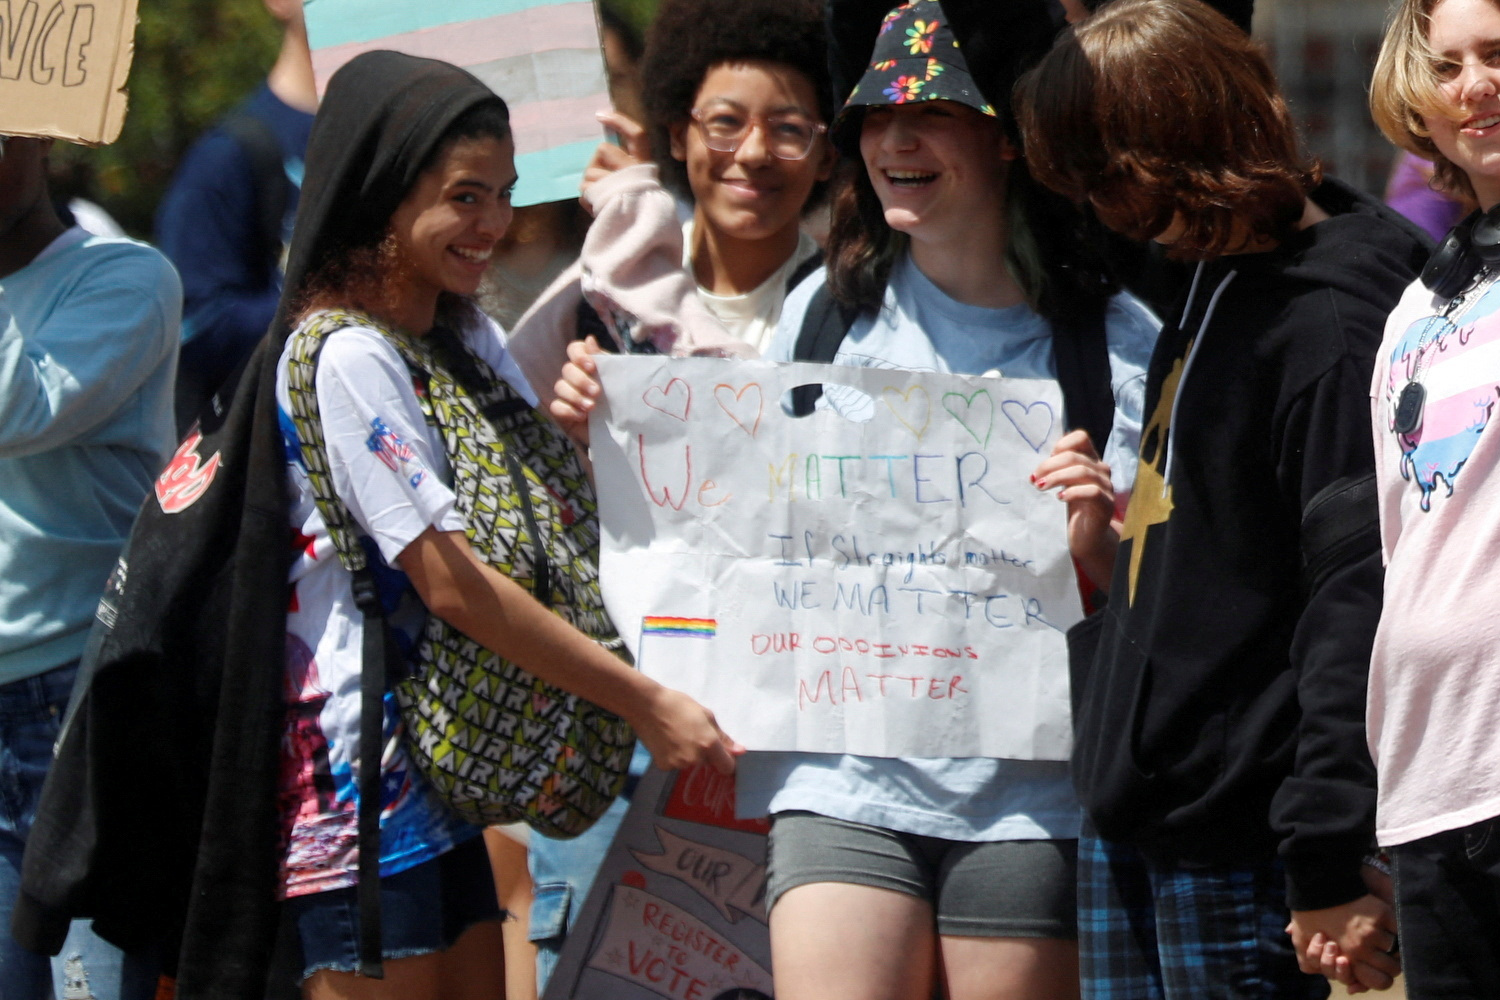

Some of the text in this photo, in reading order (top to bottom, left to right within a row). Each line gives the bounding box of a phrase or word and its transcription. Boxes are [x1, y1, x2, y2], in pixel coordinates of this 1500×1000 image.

[0, 0, 95, 88] NCE
[639, 433, 732, 511] We
[769, 451, 1011, 508] MATTER
[768, 530, 813, 567] If
[774, 581, 1067, 635] WE MATTER
[751, 632, 801, 656] OUR
[798, 666, 968, 711] MATTER
[642, 902, 740, 973] REGISTER
[628, 940, 707, 1000] VOTE
